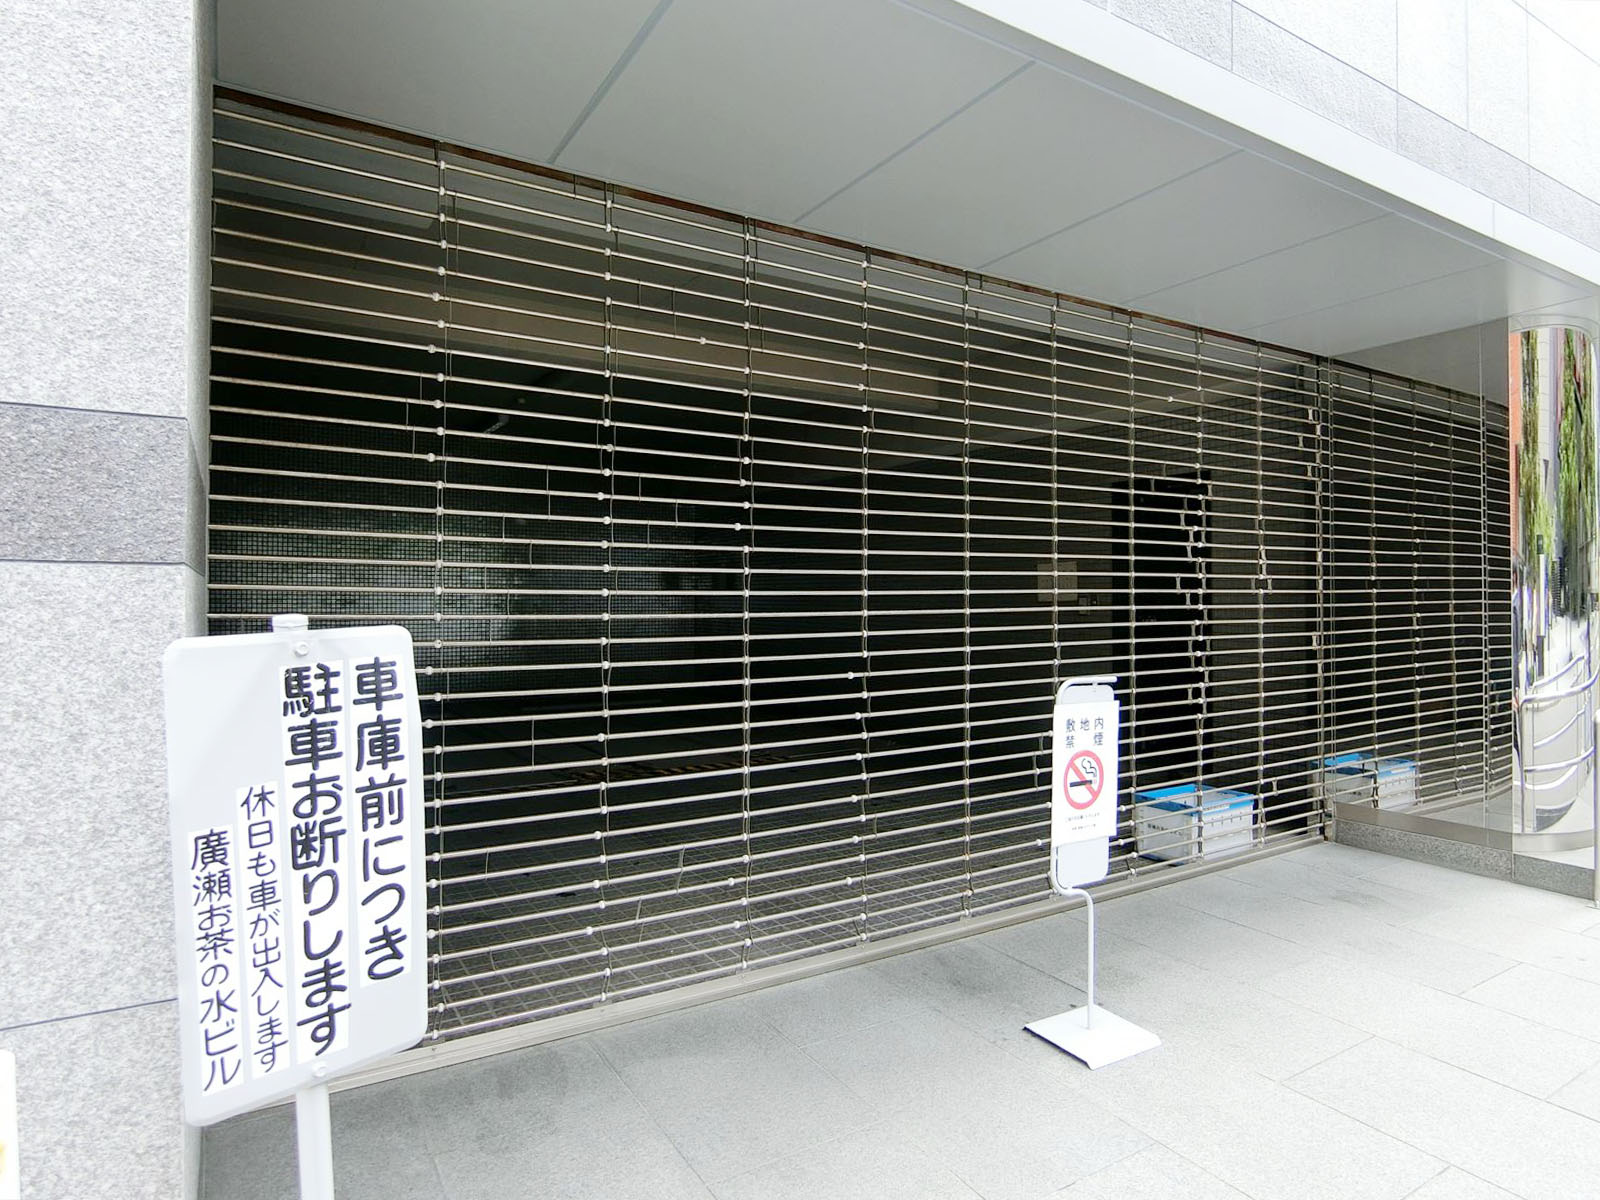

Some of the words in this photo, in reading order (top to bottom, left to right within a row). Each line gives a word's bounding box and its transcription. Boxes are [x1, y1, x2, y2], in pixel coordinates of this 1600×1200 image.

[282, 662, 352, 1057] 駐車お断りします
[353, 657, 407, 980] 車庫前につき
[1065, 732, 1104, 749] 禁煙
[1066, 717, 1104, 732] 敷地内
[191, 828, 241, 1091] 廣瀬お茶の水ビル
[240, 785, 288, 1073] 休日も車が出入します
